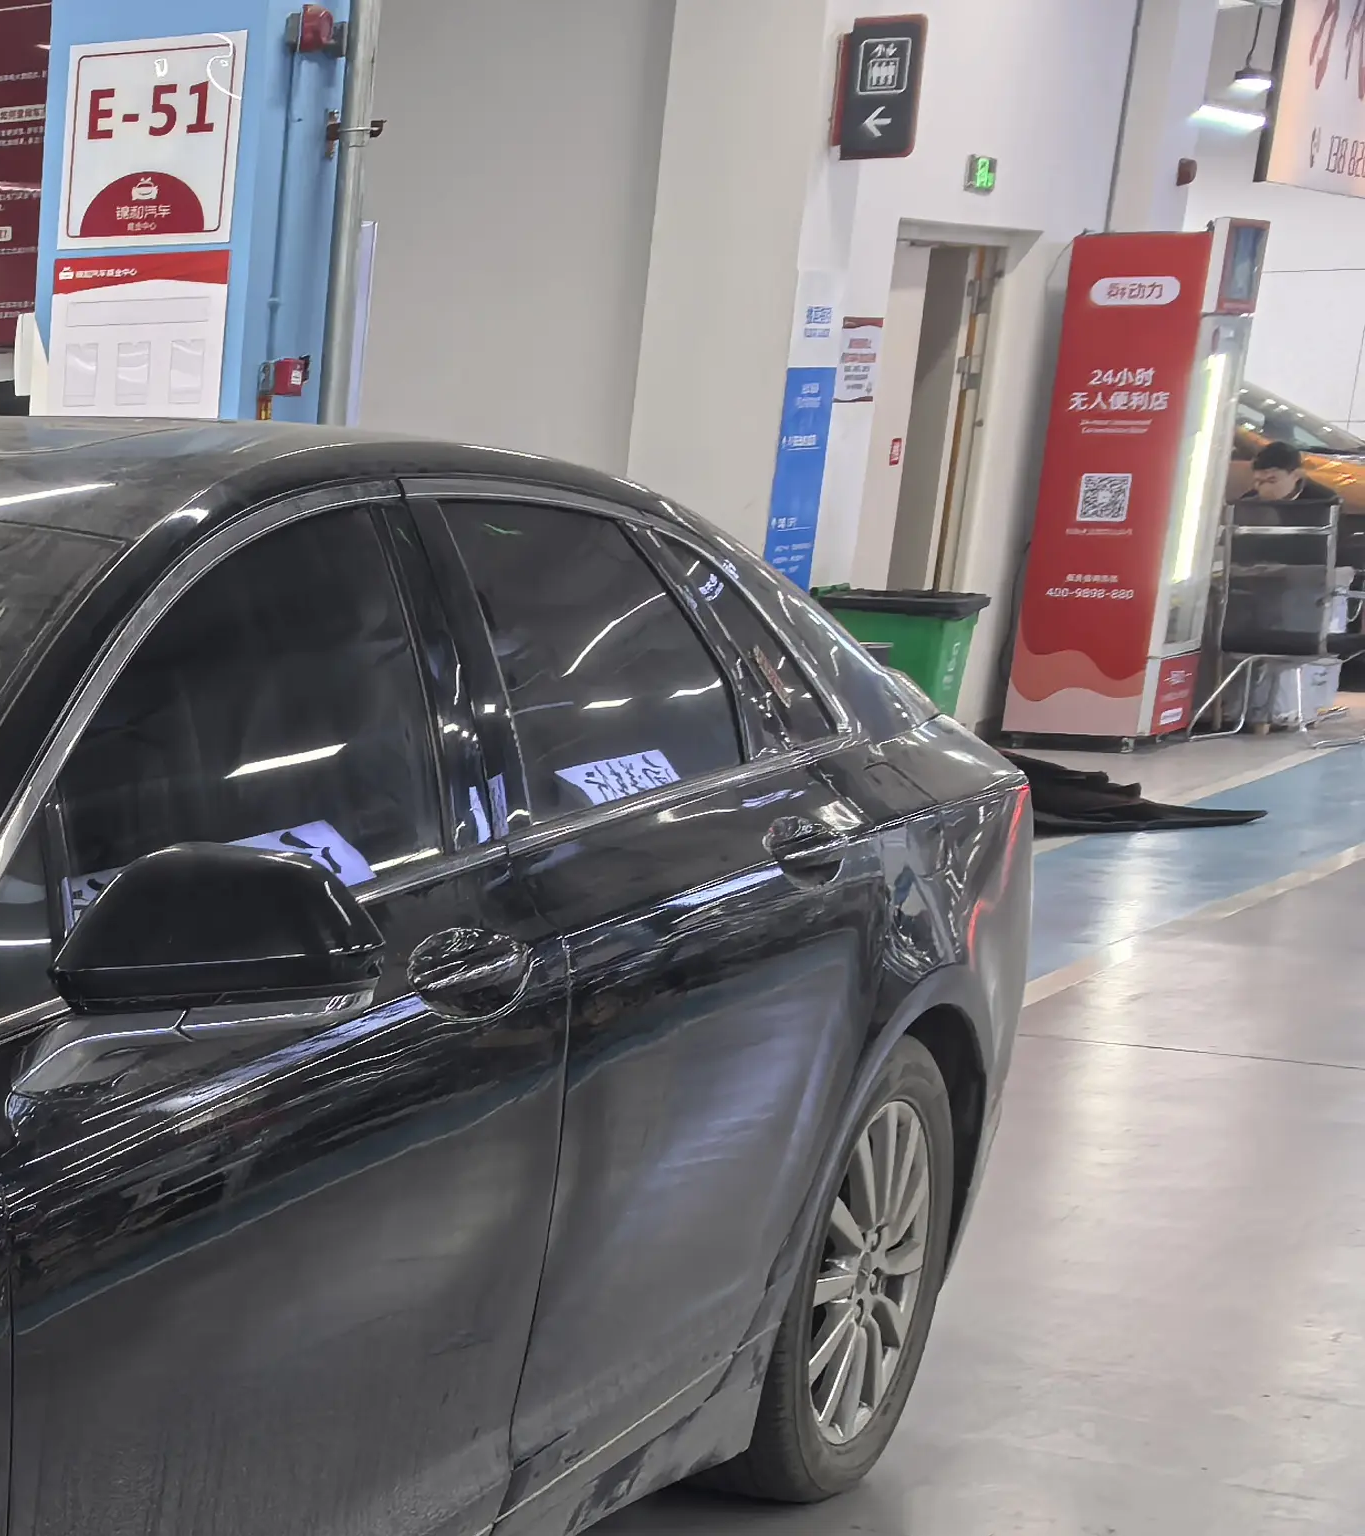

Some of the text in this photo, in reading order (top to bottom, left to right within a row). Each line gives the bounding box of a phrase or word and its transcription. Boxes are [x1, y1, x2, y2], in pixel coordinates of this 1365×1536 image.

[87, 80, 215, 140] E-51
[115, 204, 172, 221] 锦和汽车
[1087, 367, 1156, 388] 24小时
[1067, 391, 1171, 413] 无人便利店
